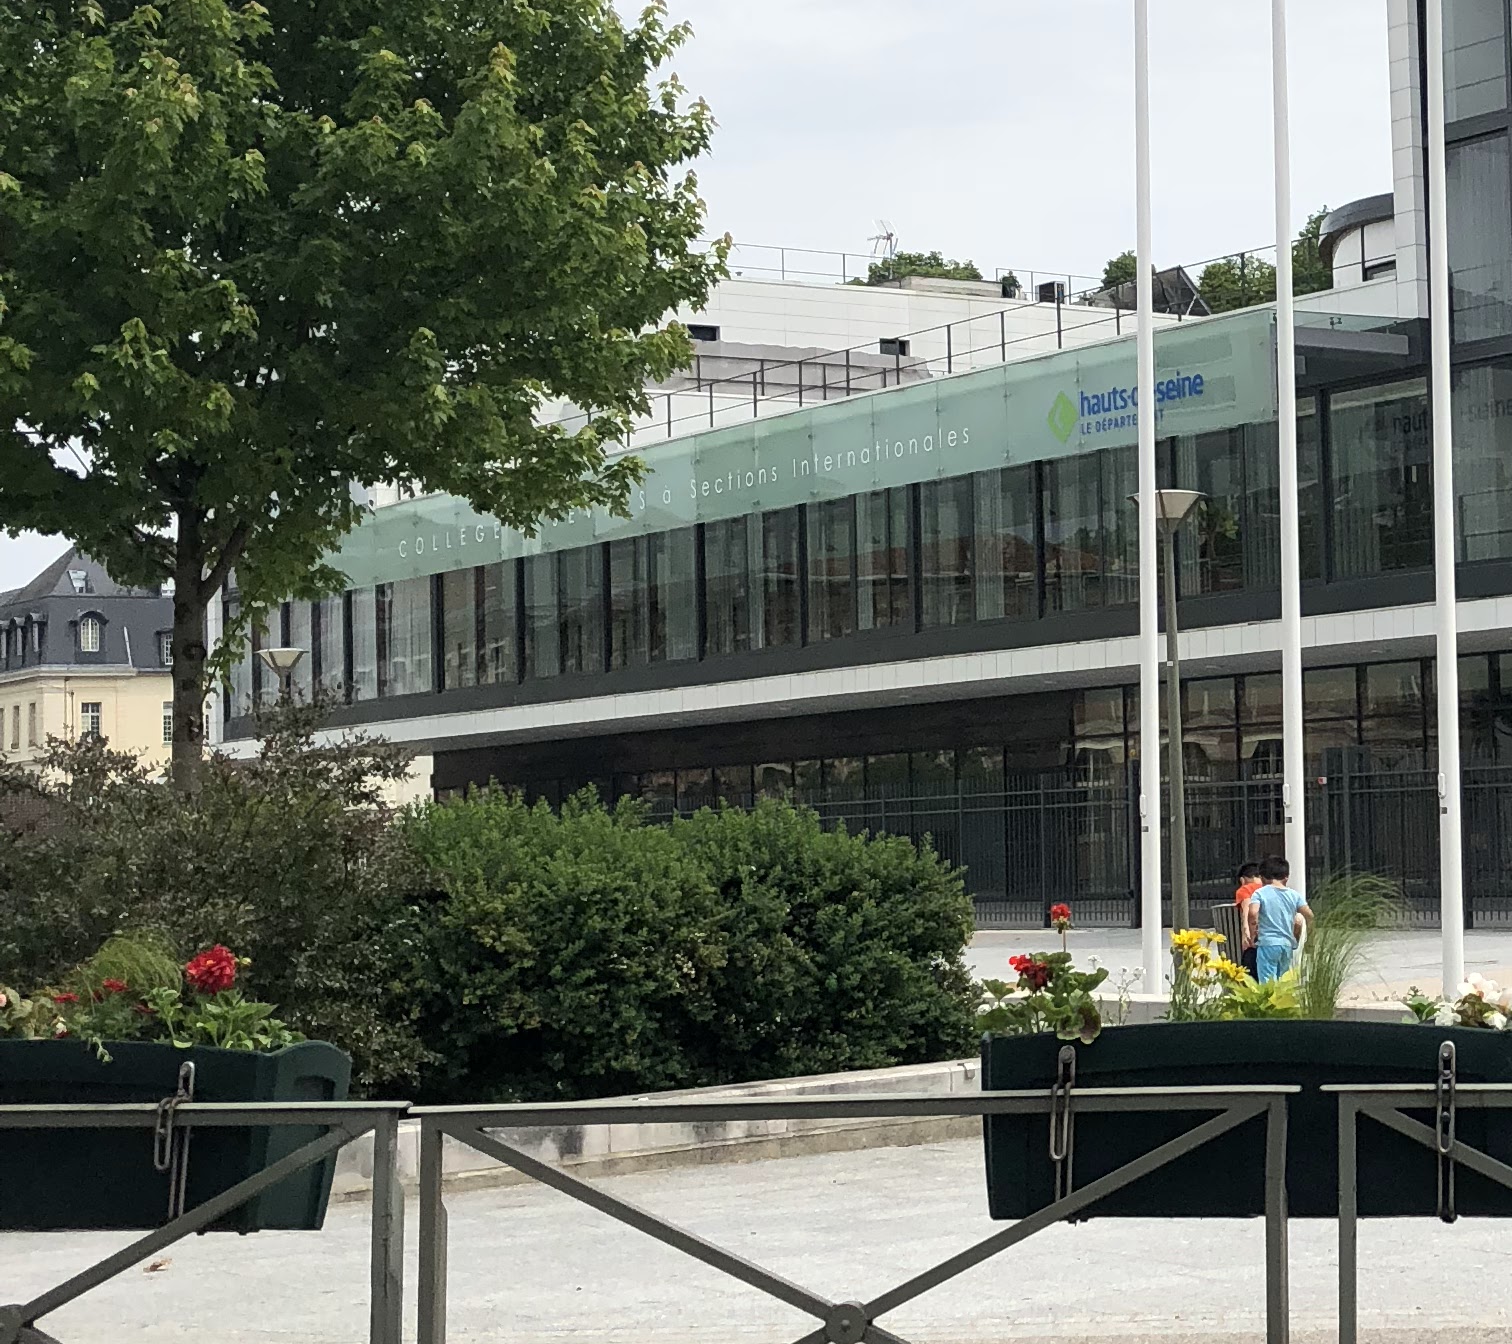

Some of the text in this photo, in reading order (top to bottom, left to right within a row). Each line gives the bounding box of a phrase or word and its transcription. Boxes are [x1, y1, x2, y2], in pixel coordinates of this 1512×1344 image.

[1081, 423, 1092, 435] LE
[399, 521, 500, 558] COLLEGE
[663, 484, 672, 504] à
[690, 466, 778, 500] Sections
[792, 427, 970, 476] Internationales
